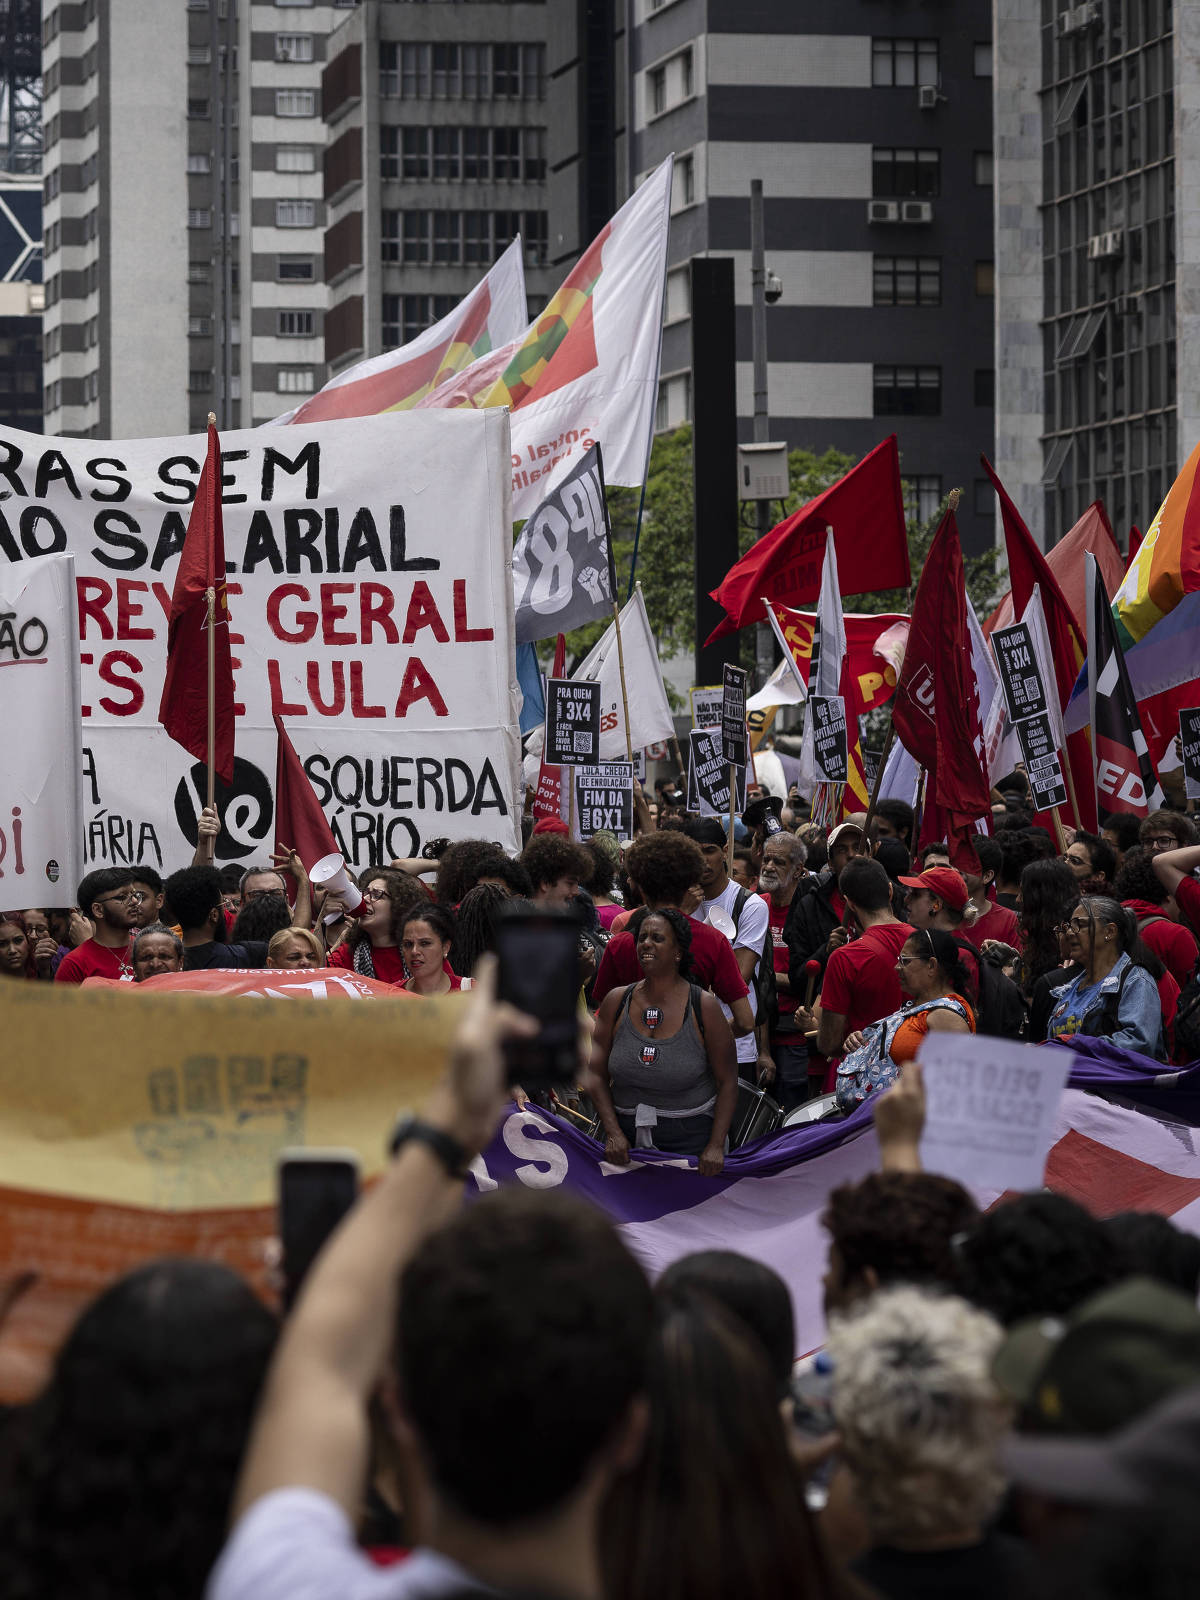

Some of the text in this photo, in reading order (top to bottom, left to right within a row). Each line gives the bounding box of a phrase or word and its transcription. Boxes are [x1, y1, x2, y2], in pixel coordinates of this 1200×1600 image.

[153, 442, 321, 504] SEM
[91, 505, 441, 574] SAARIAL
[266, 578, 494, 645] GERAL
[1011, 645, 1031, 670] 3X4
[268, 657, 449, 717] LULA
[557, 687, 592, 700] PRA QUEM
[566, 701, 591, 721] 3X4
[697, 702, 710, 713] NÃO
[600, 712, 618, 733] ES
[541, 775, 554, 786] Em
[604, 766, 628, 776] CHEGA
[305, 753, 508, 816] SQUERDA
[581, 778, 590, 787] DE
[538, 787, 556, 800] Por
[584, 790, 624, 807] FIM DA
[535, 799, 554, 813] Pela
[582, 808, 591, 830] ESCALA
[592, 808, 624, 830] 6X1
